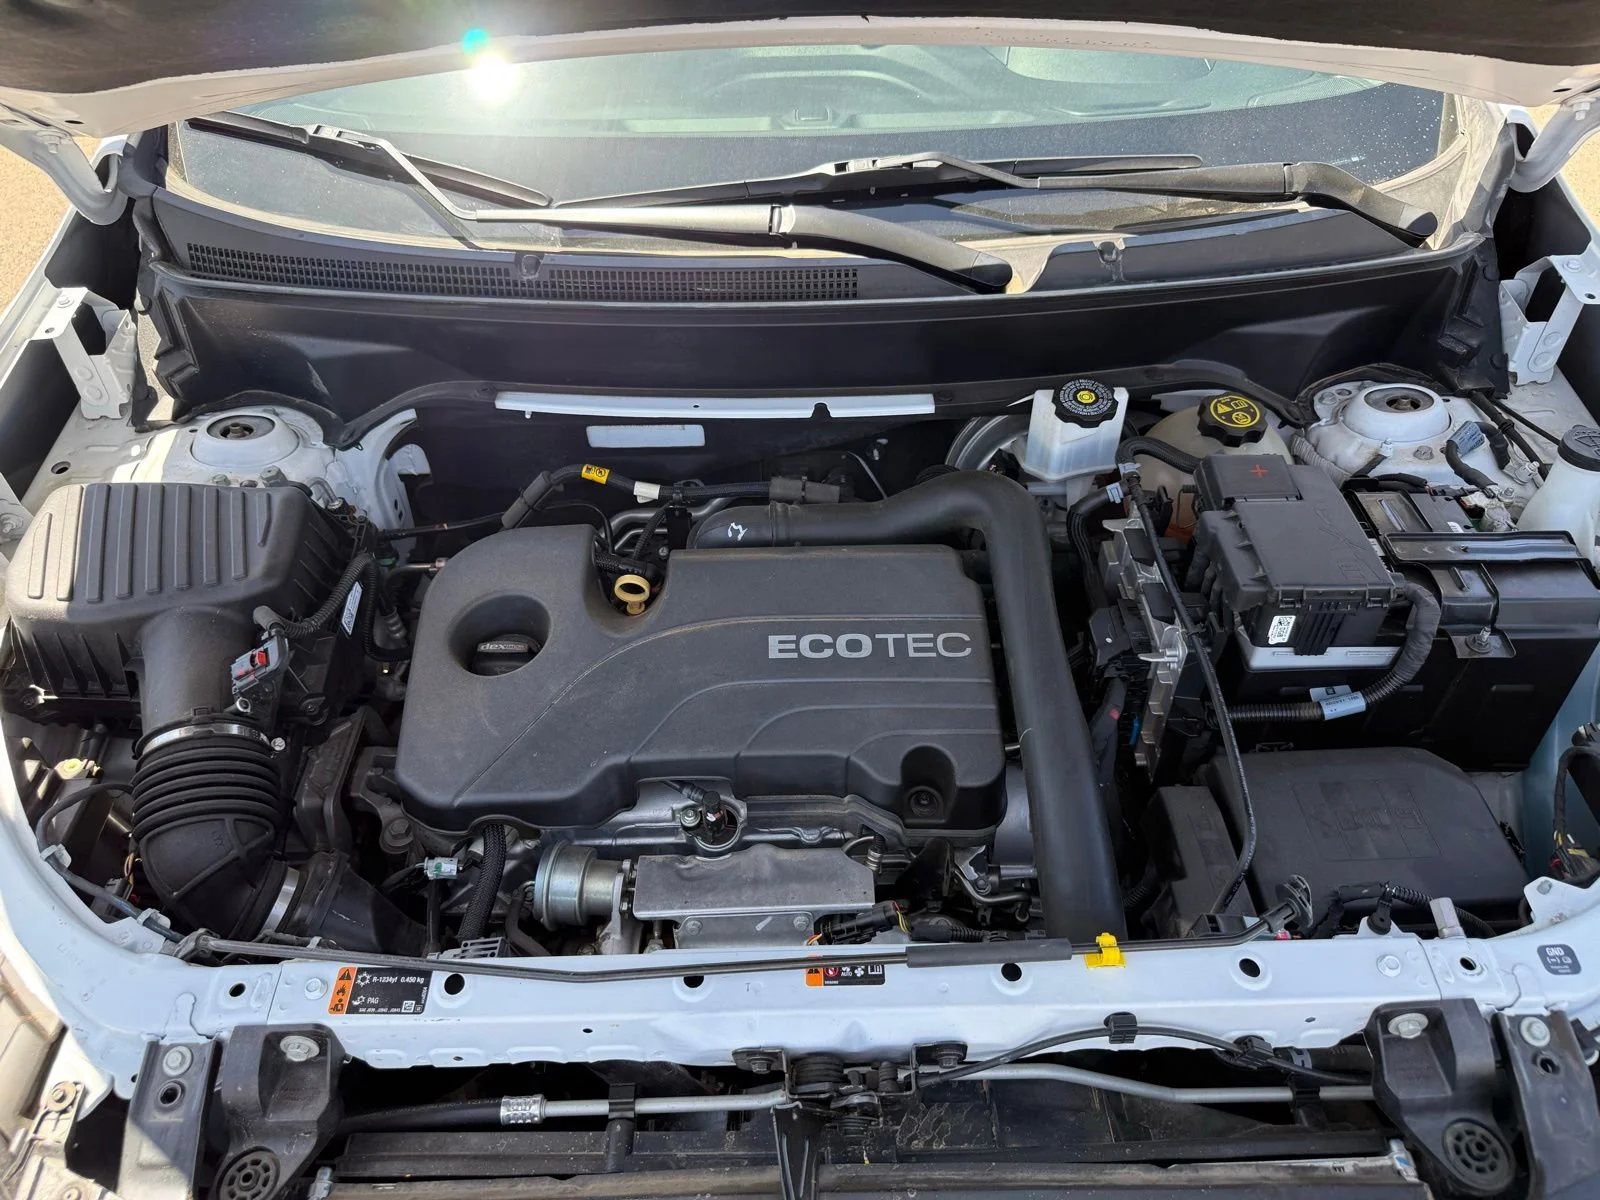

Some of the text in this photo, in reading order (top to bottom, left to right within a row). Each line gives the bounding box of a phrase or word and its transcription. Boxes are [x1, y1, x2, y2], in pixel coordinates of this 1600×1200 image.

[768, 632, 972, 659] ECOTEC
[1545, 947, 1565, 956] GND
[372, 976, 398, 984] R-1234yf
[416, 976, 425, 984] kg
